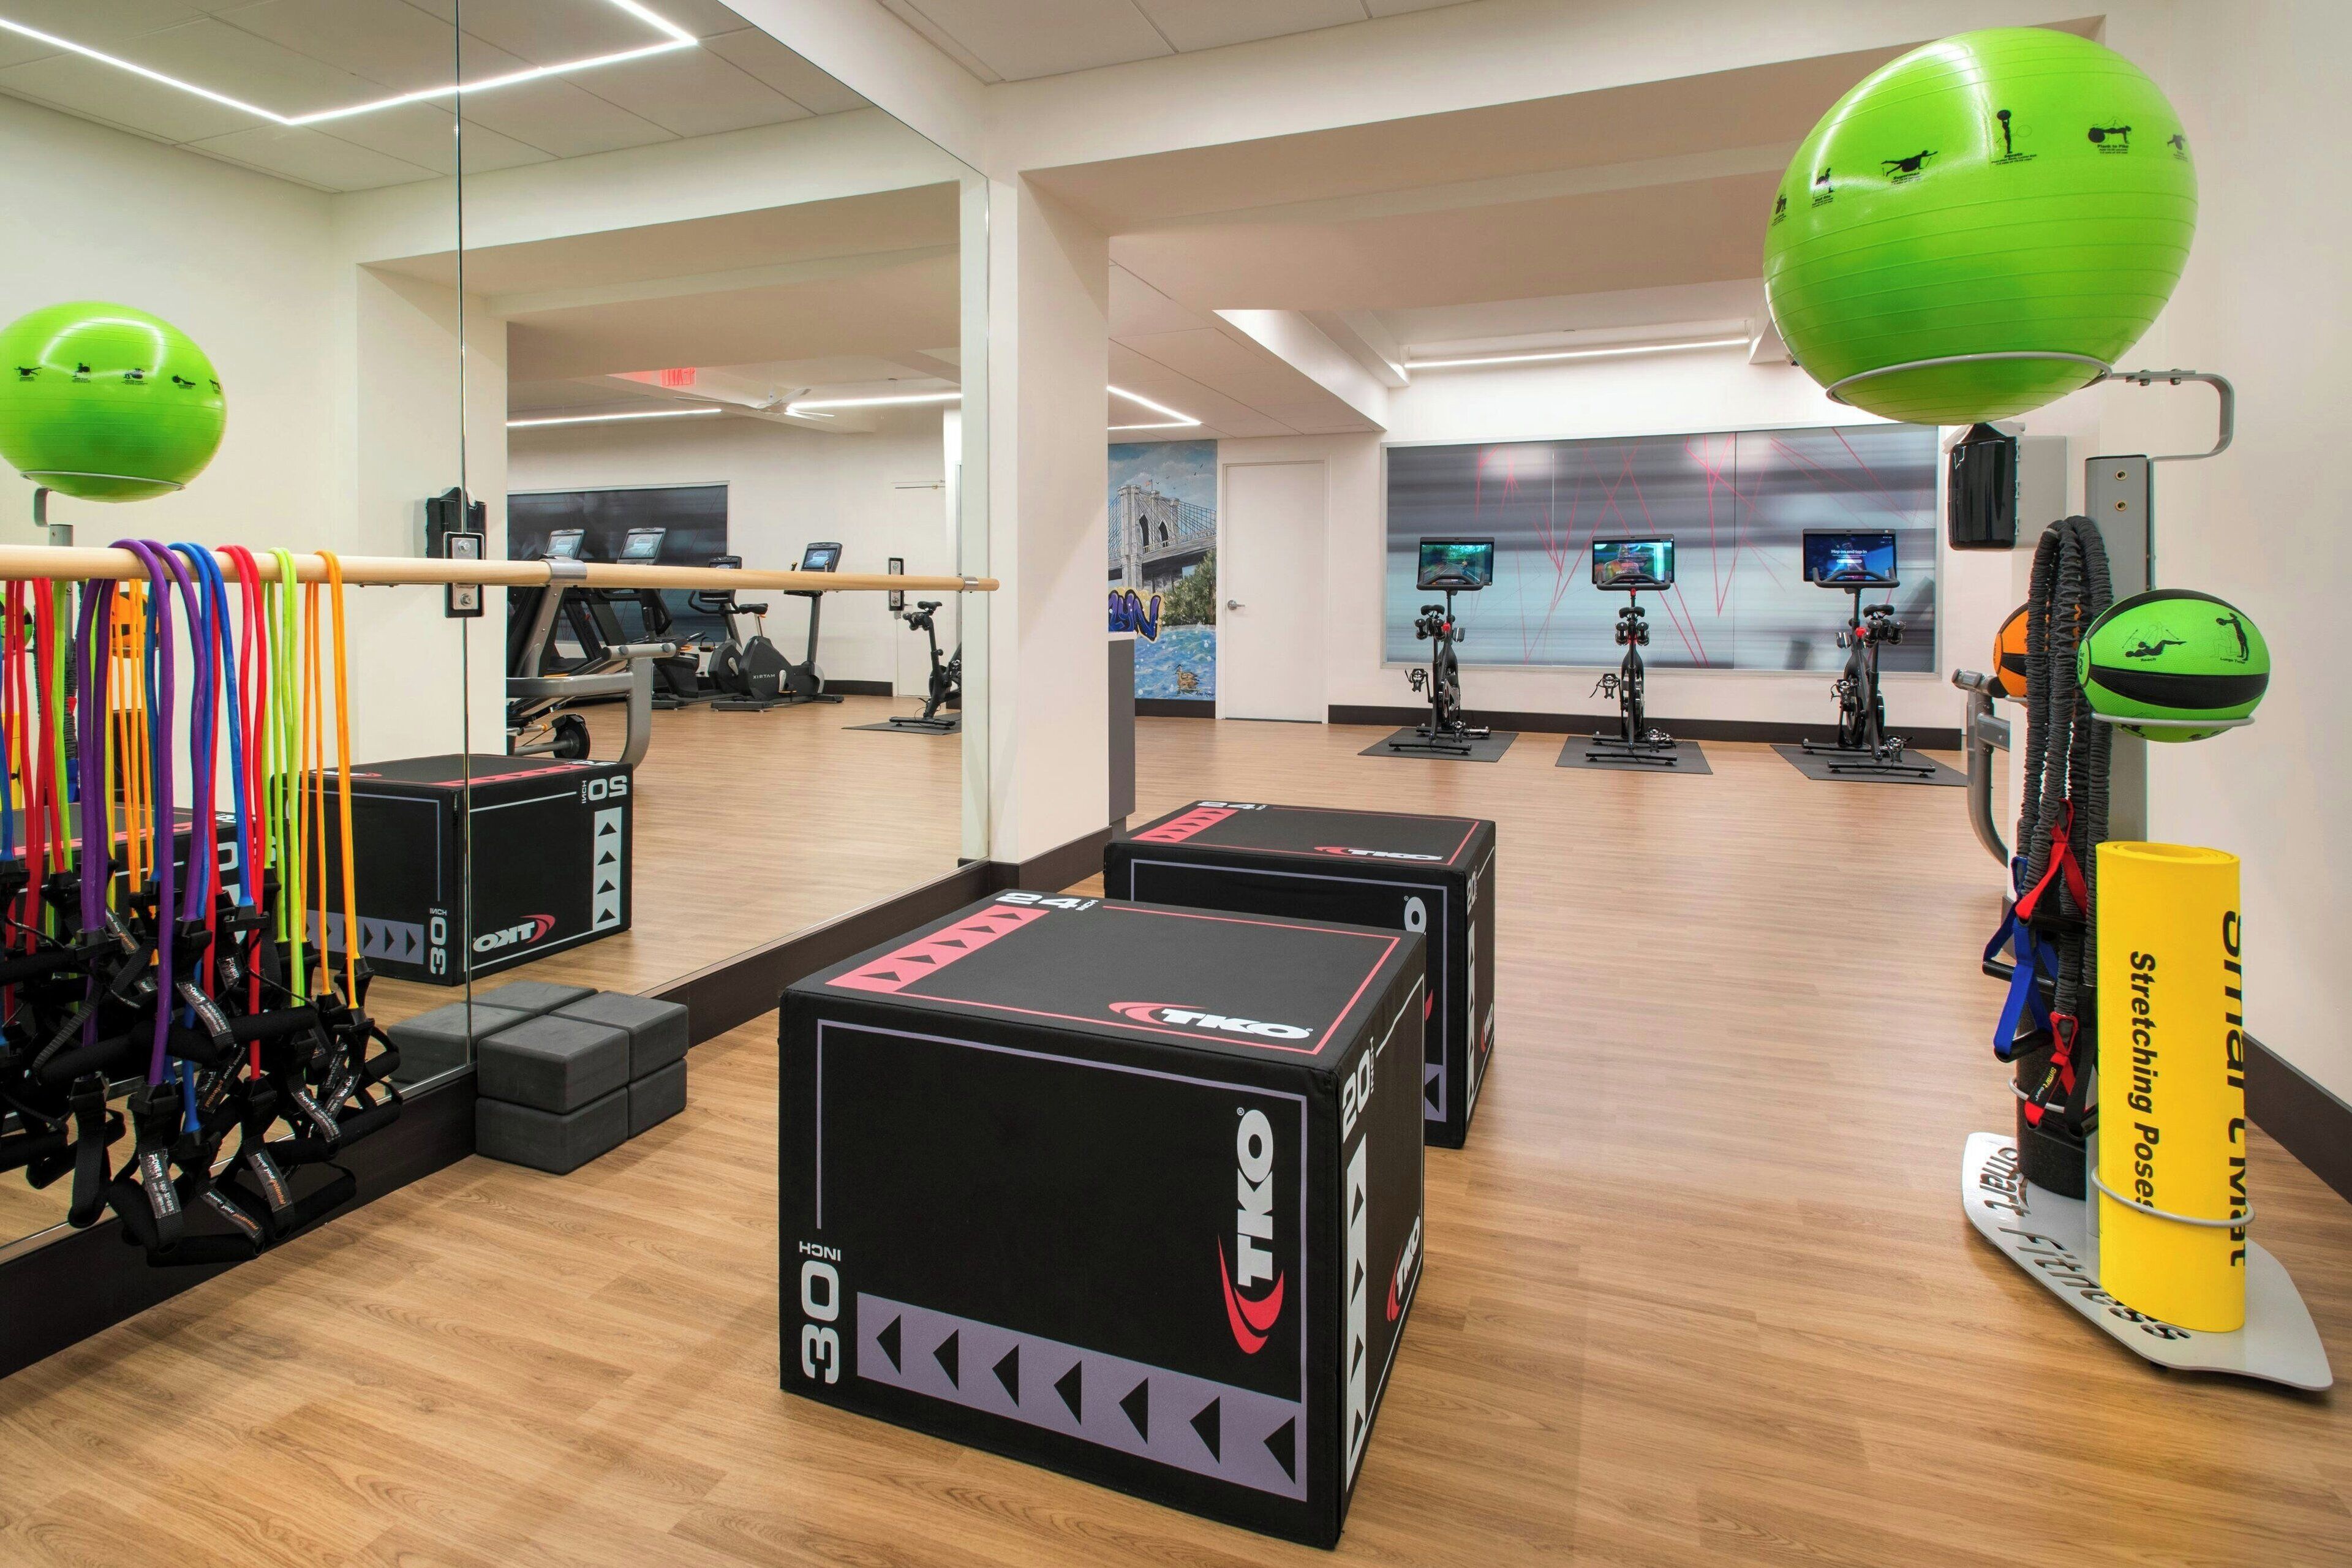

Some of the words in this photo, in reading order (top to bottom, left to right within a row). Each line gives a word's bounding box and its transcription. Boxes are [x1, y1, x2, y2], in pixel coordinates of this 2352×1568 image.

[1348, 849, 1442, 861] TKO
[995, 892, 1082, 909] 24
[1466, 870, 1476, 916] 20
[225, 957, 240, 979] POWER
[1161, 1008, 1311, 1039] TKO
[2127, 951, 2158, 1114] Stretching
[1342, 1049, 1371, 1144] 20
[2045, 1066, 2057, 1088] Smart
[148, 1153, 163, 1178] POWER
[254, 1153, 269, 1168] power
[263, 1167, 276, 1180] your
[270, 1179, 287, 1205] potential
[206, 1191, 224, 1205] power
[221, 1204, 236, 1214] your
[233, 1213, 259, 1231] potential
[1237, 1109, 1274, 1287] TKO
[799, 1240, 841, 1262] INCH
[1396, 1215, 1421, 1301] TKO
[1997, 1226, 2192, 1340] Fitness
[801, 1259, 840, 1384] 30
